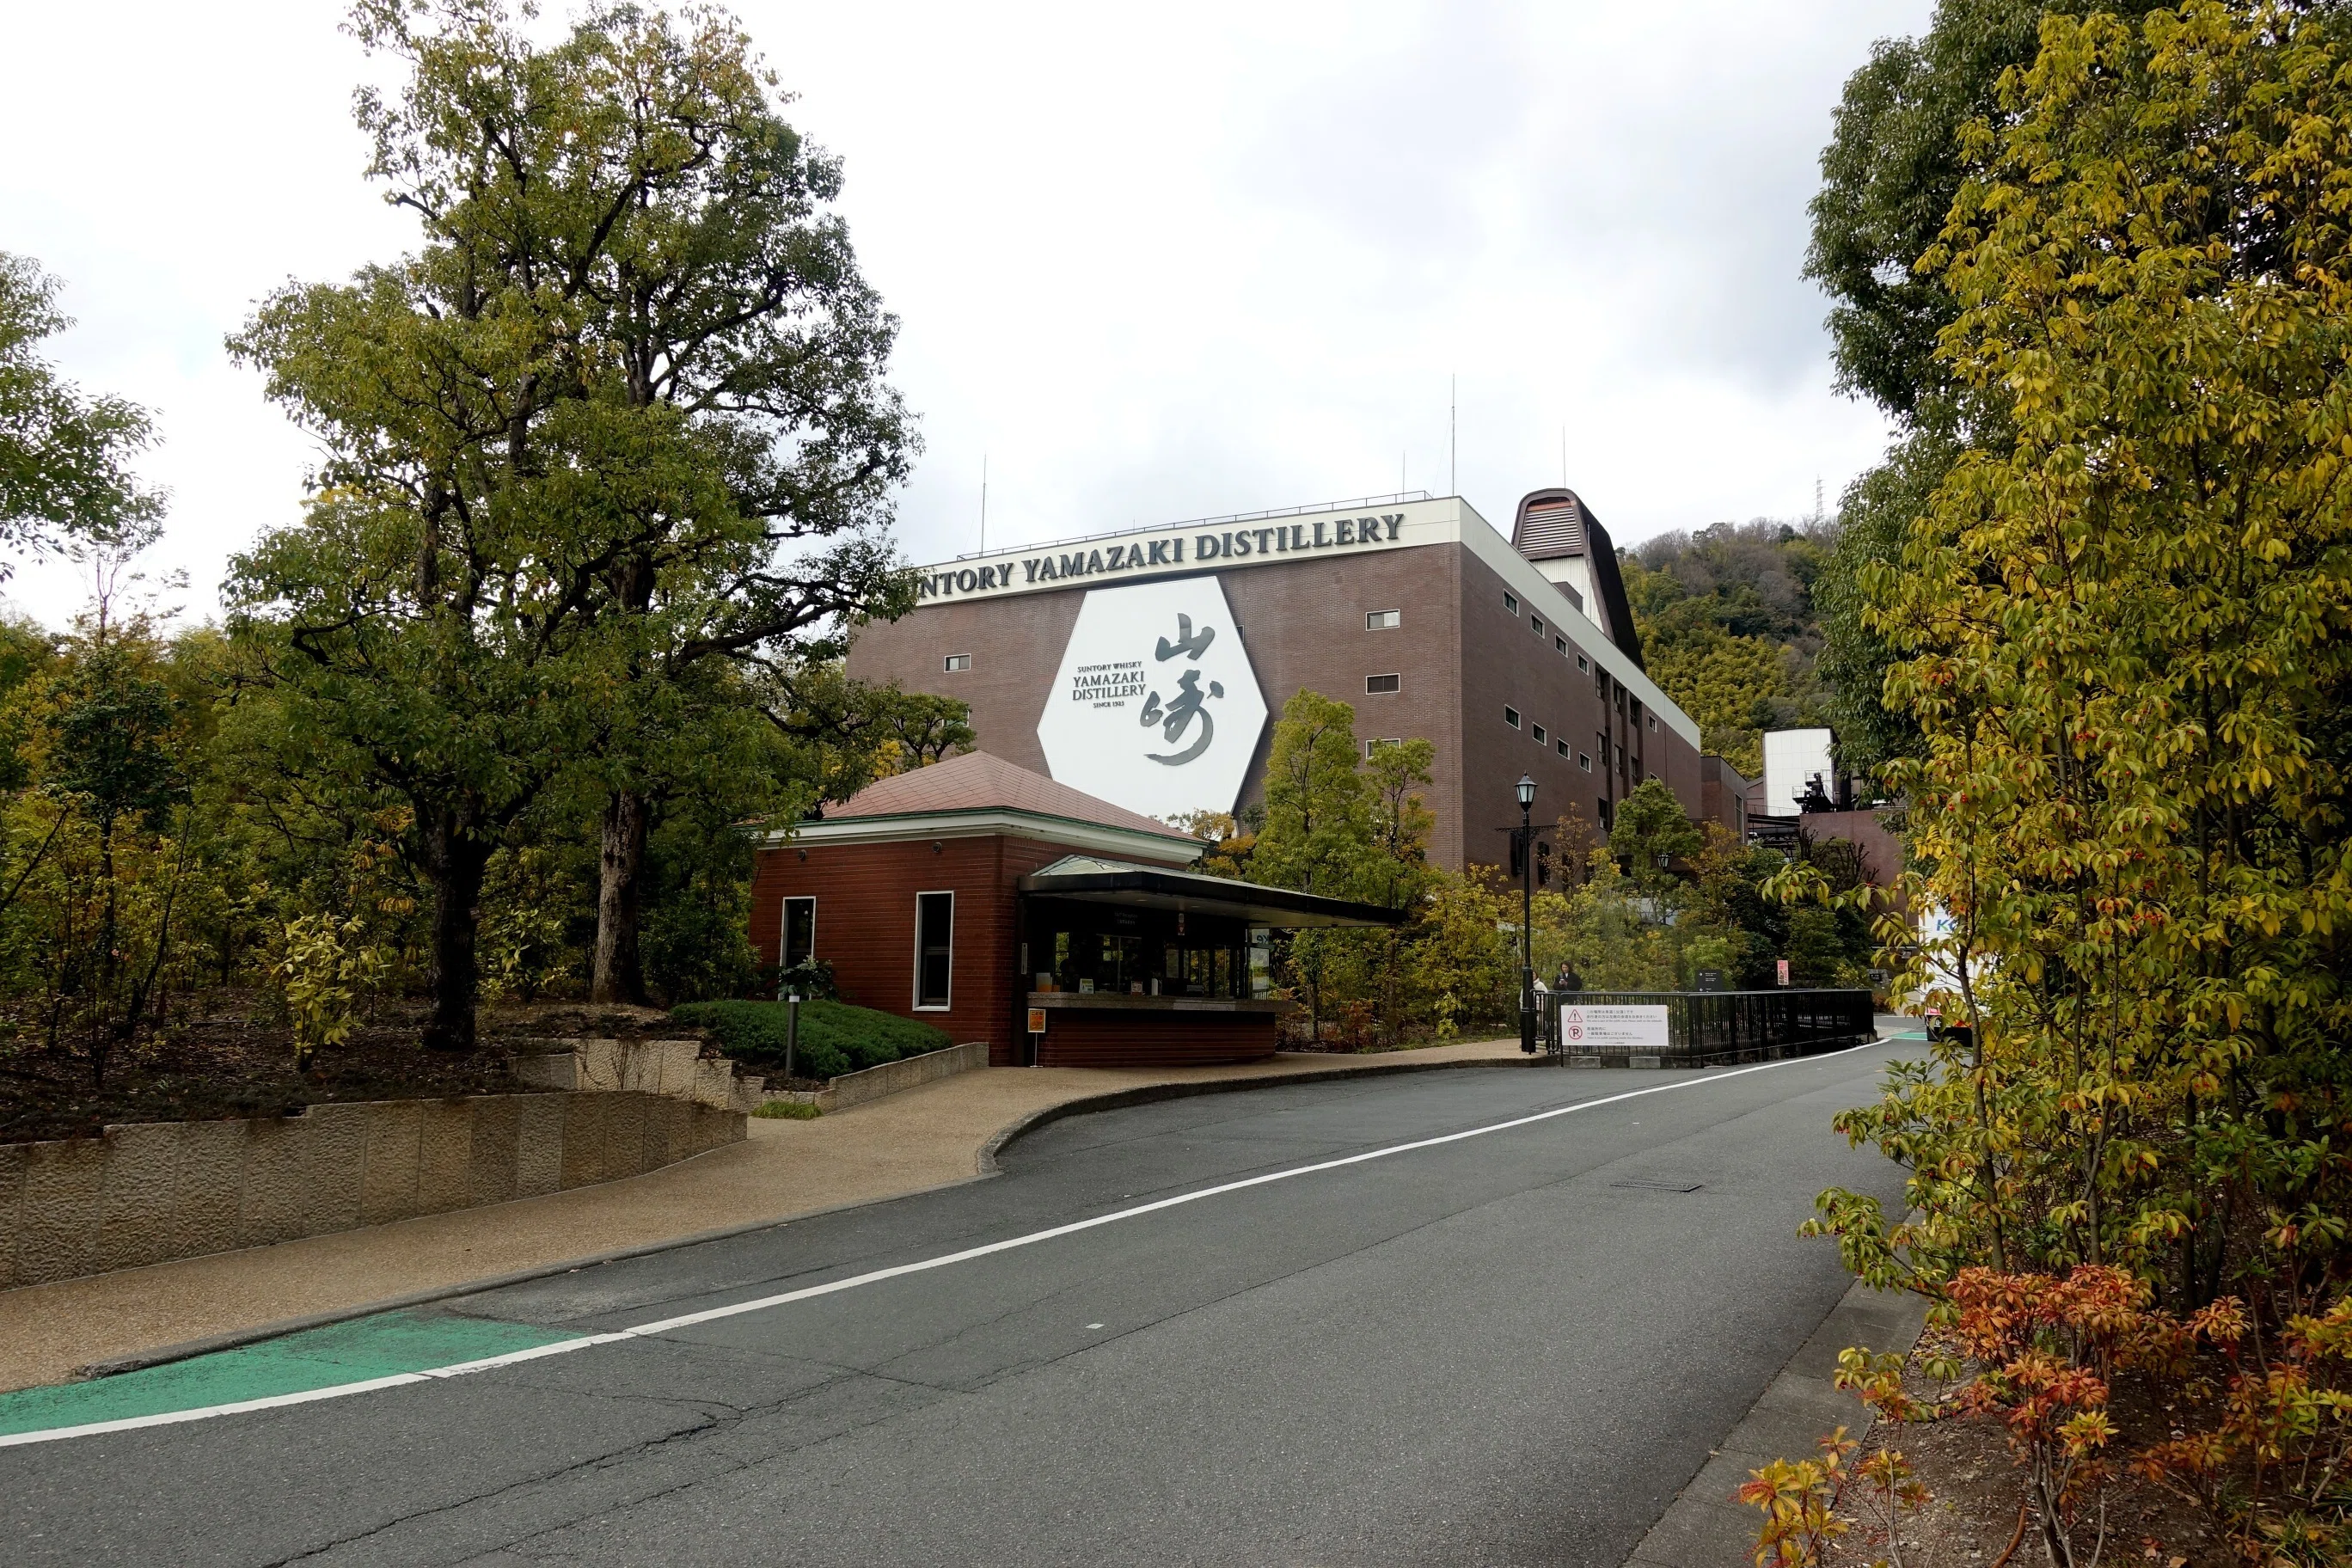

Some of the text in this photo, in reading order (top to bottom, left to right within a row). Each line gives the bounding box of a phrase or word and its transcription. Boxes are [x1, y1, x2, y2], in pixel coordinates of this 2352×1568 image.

[920, 513, 1404, 598] NTORY YAMAZAKI DISTILLERY
[1077, 660, 1142, 673] SUNTORY WHISKY
[1073, 671, 1144, 688] YAMAZAKI
[1072, 683, 1146, 701] DISTILLERY
